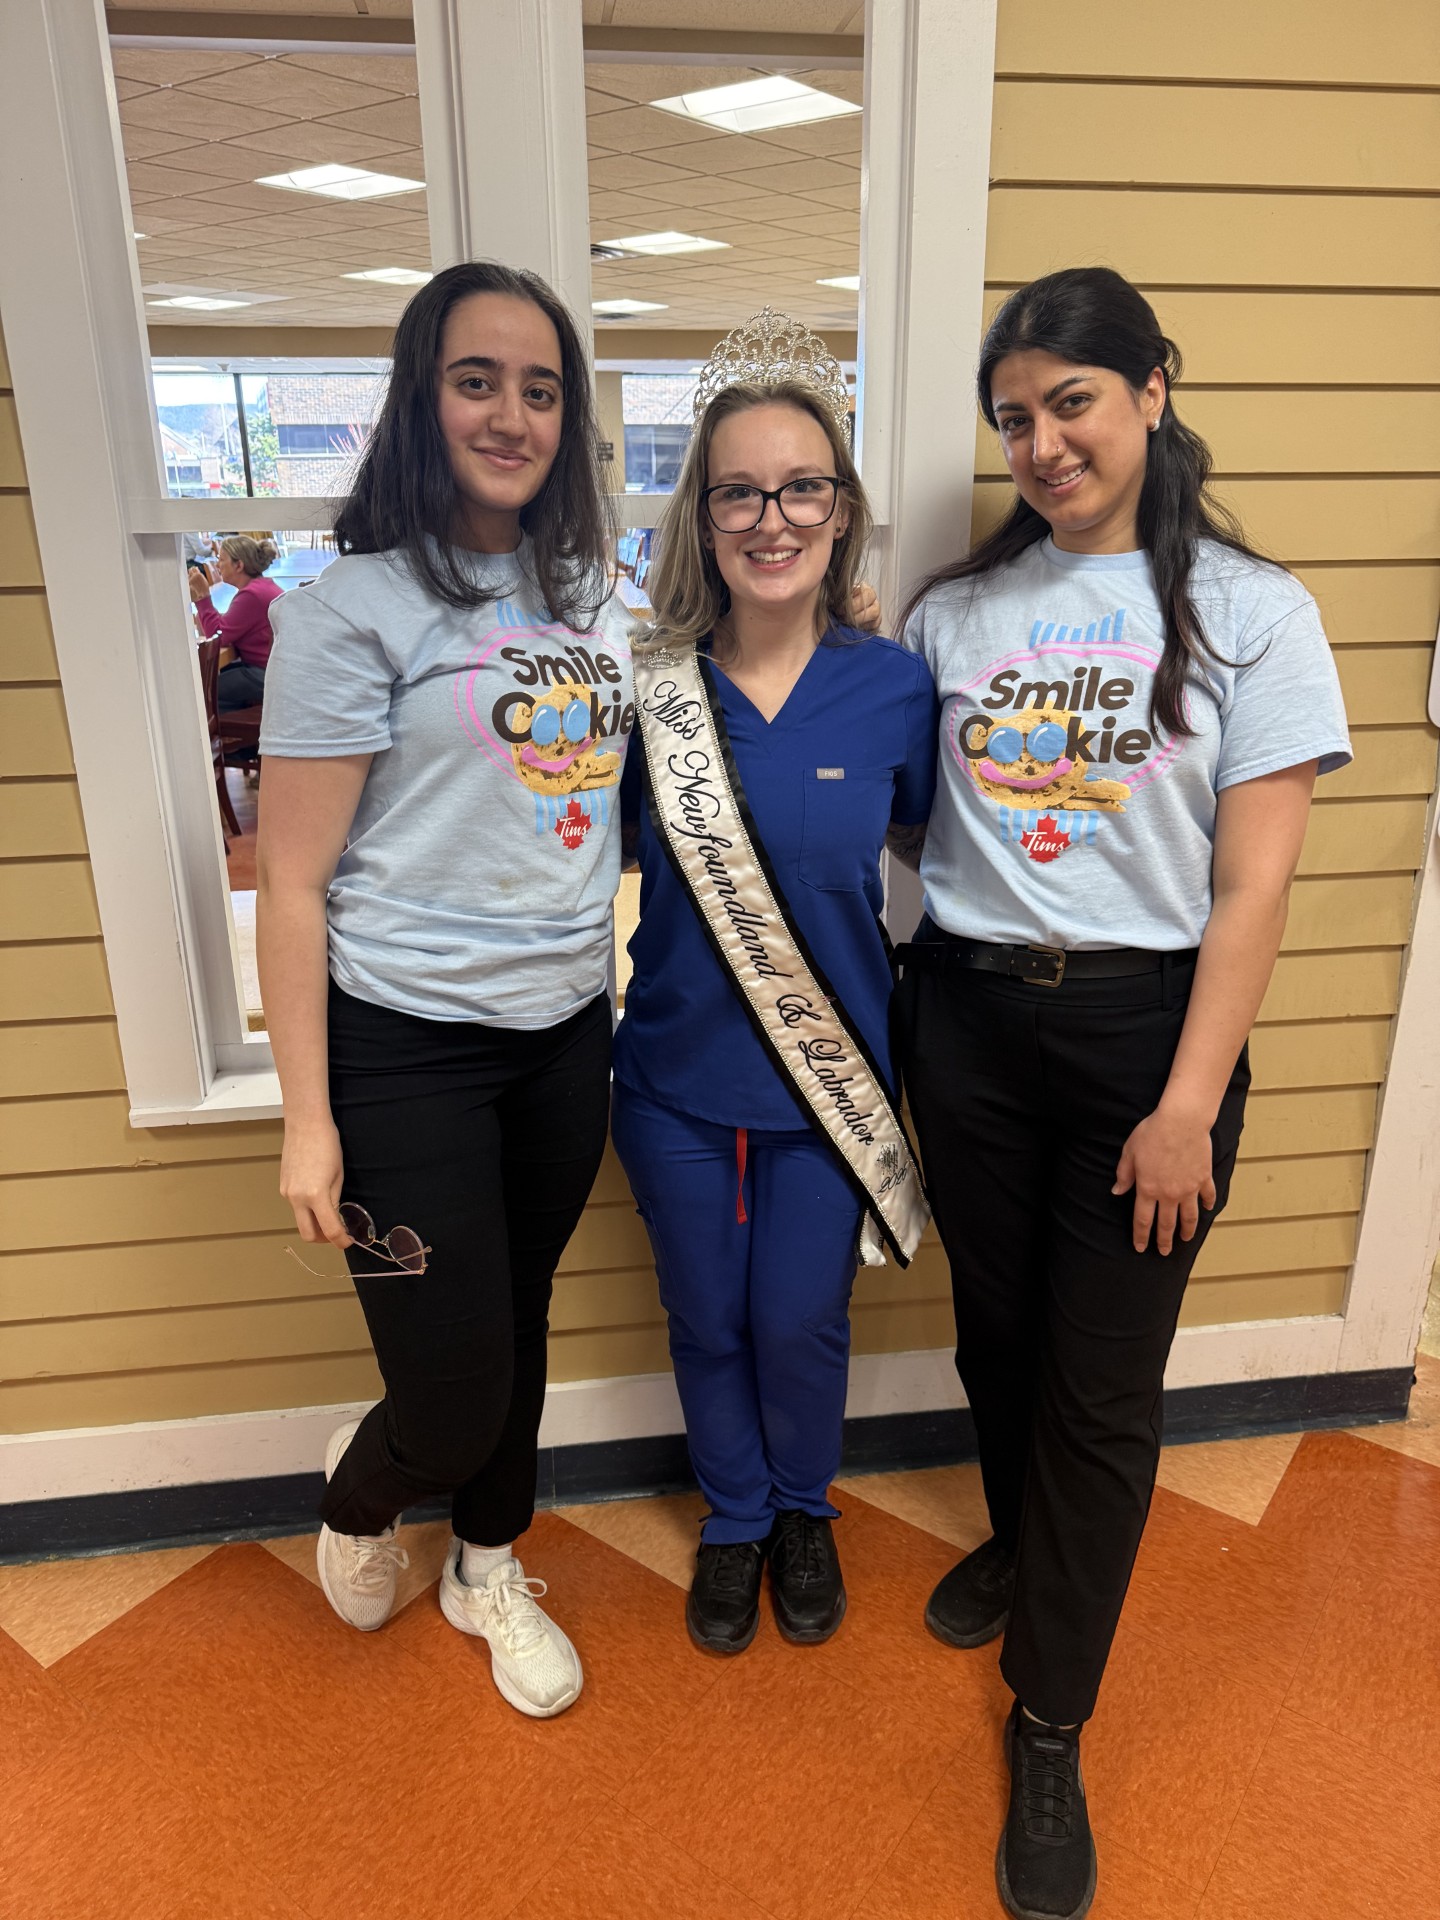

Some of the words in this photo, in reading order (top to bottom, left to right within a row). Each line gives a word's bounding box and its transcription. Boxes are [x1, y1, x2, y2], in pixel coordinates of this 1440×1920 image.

[500, 646, 623, 686] Smile
[980, 666, 1135, 711] Smile
[491, 689, 635, 745] Cookie
[642, 680, 706, 741] Miss
[959, 714, 1152, 765] Cookie
[559, 817, 588, 838] Tims
[1026, 831, 1065, 852] Tims
[667, 750, 795, 980] Newfoundland
[798, 1038, 875, 1147] Labrador
